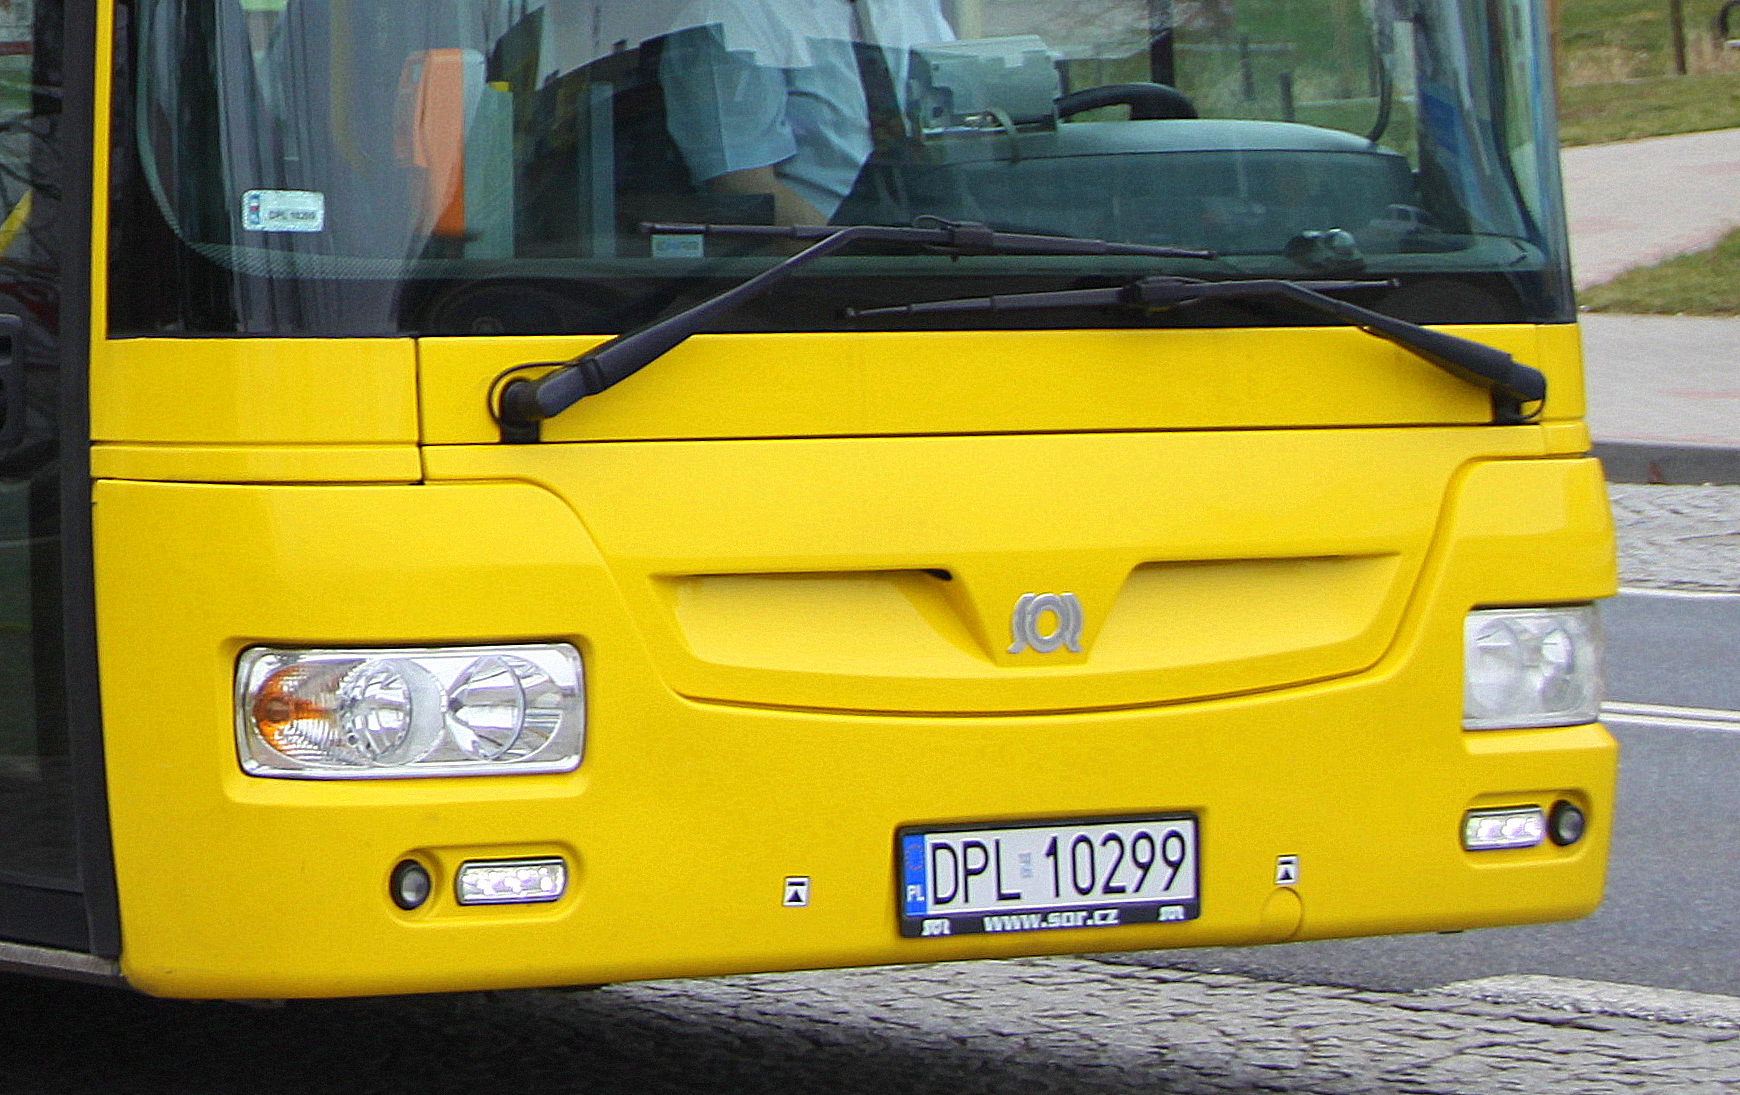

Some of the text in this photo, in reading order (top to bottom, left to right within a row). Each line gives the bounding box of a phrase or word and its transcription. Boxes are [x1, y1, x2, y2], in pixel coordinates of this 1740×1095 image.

[931, 829, 1186, 905] DPL 10299
[905, 884, 926, 903] PL
[983, 908, 1121, 933] www.sor.cz
